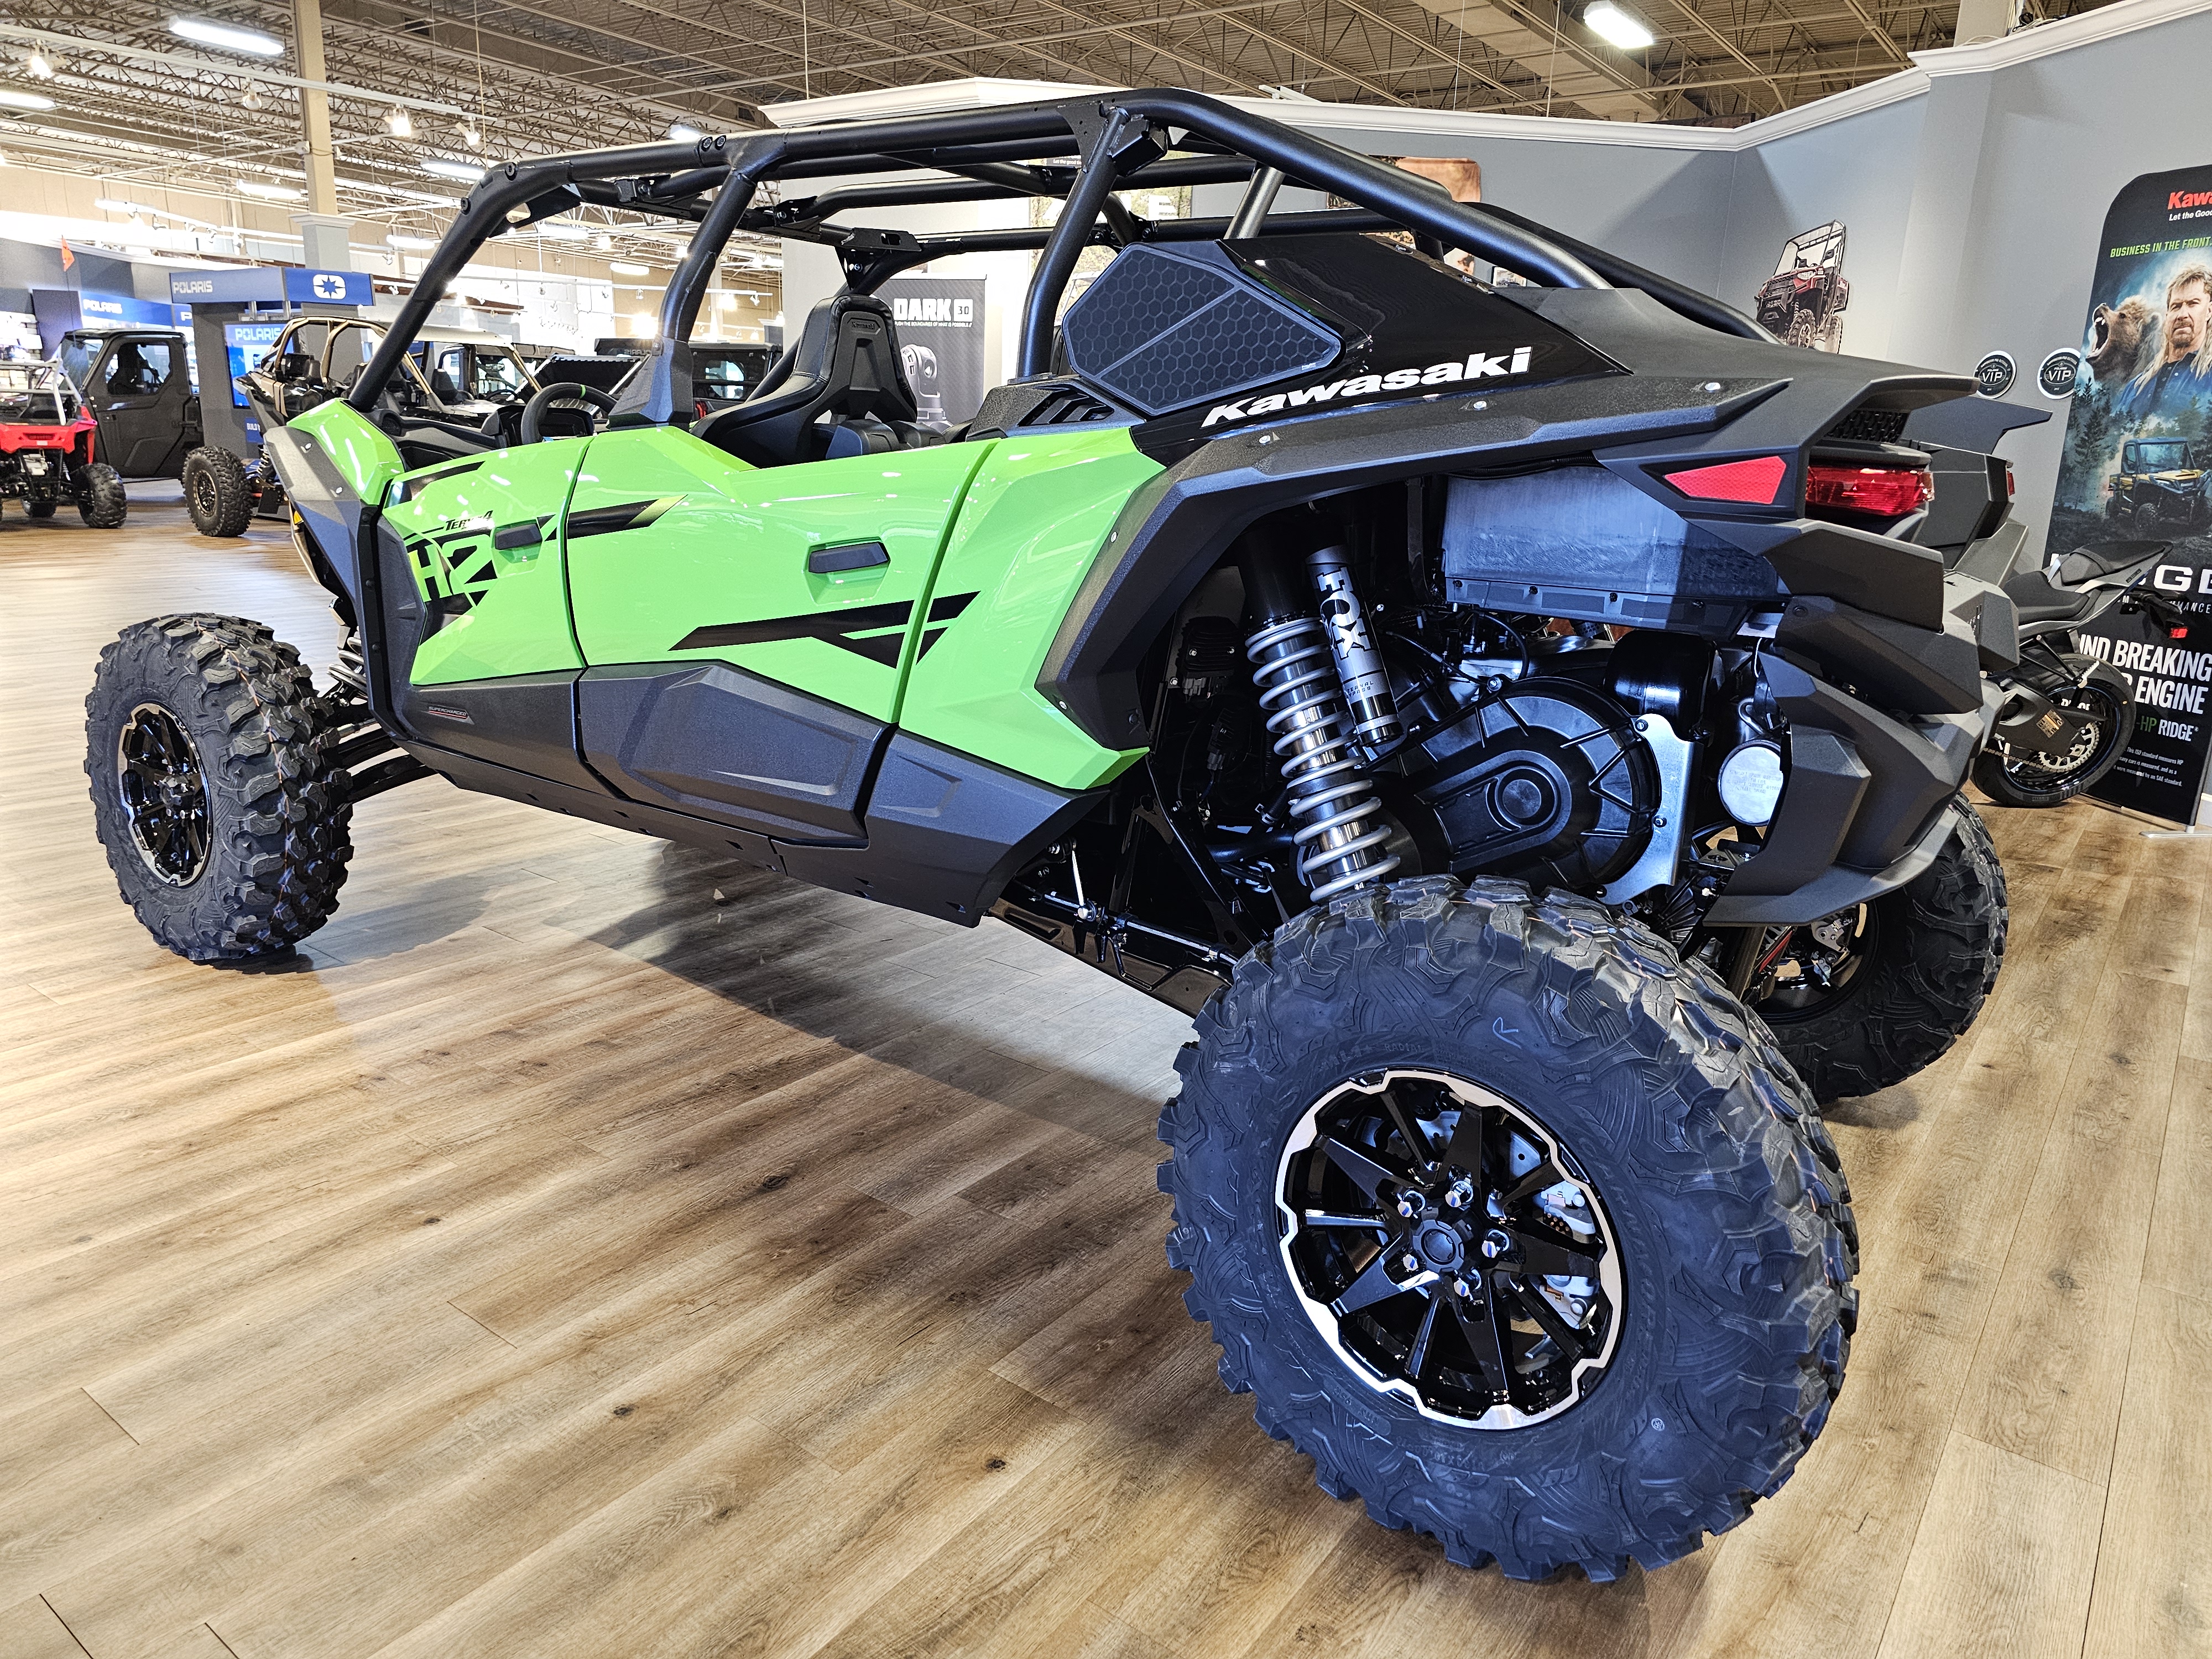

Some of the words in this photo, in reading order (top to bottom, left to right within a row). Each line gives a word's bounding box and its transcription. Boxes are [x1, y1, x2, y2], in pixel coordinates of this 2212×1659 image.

[2169, 213, 2180, 221] Let
[2110, 244, 2151, 258] BUSINESS
[2152, 243, 2162, 252] IN
[2164, 241, 2180, 251] THE
[173, 280, 213, 294] POLARIS
[83, 299, 123, 314] POLARIS
[894, 298, 952, 321] DARK
[958, 306, 969, 315] 30
[235, 327, 281, 341] POLARIS
[1982, 372, 2002, 382] VIP
[2048, 370, 2072, 381] VIP
[1201, 346, 1532, 428] Kawasaki
[408, 534, 497, 603] H2
[1315, 566, 1372, 660] FOX
[2112, 640, 2212, 682] BREAKING
[1348, 681, 1374, 693] TERNAL
[1349, 686, 1371, 697] YPASS
[2135, 676, 2209, 714] ENGINE
[429, 706, 467, 716] SUPERCHARGED
[1384, 1042, 1423, 1053] RADIAL
